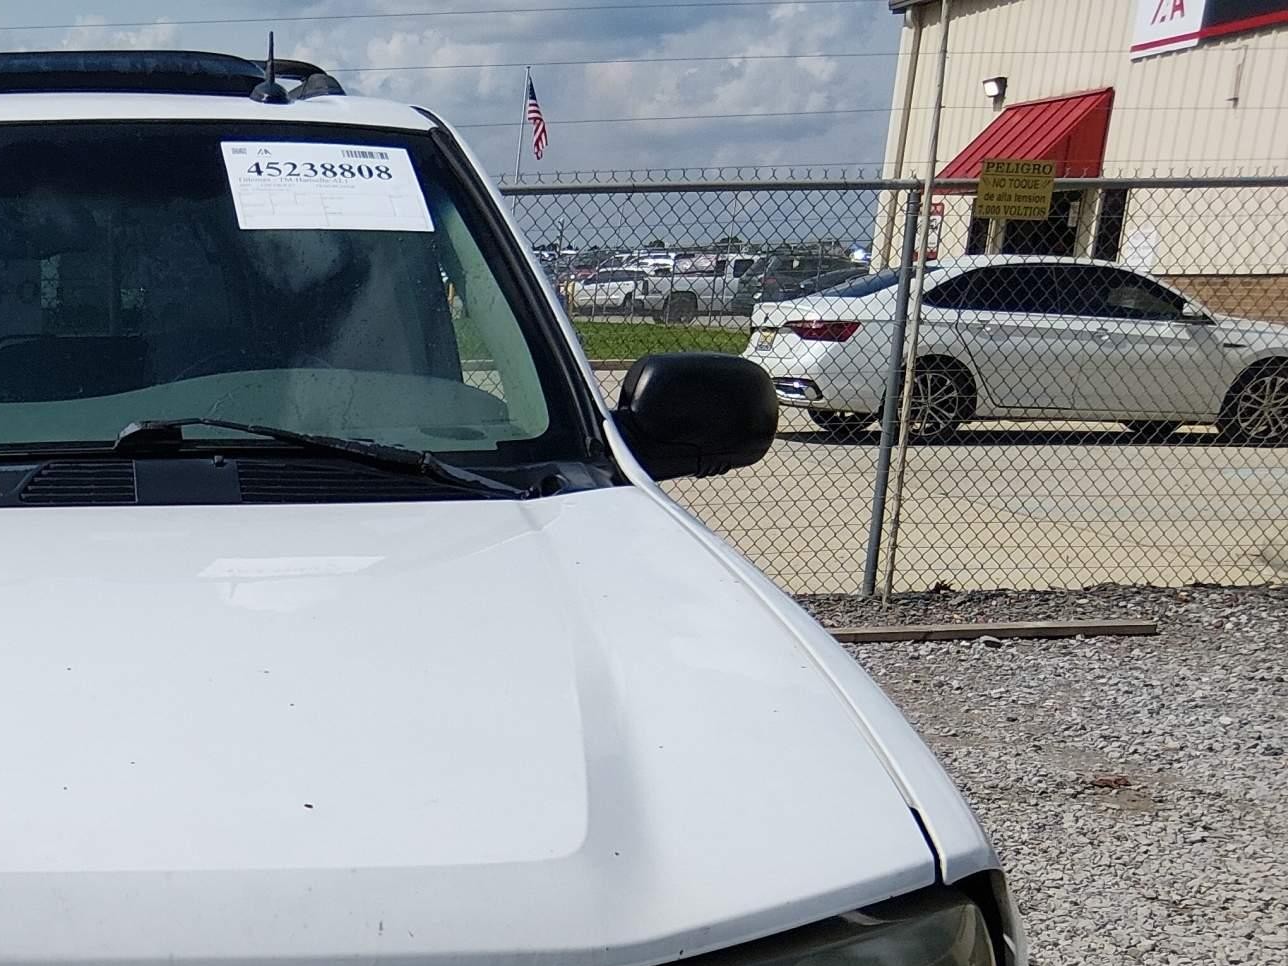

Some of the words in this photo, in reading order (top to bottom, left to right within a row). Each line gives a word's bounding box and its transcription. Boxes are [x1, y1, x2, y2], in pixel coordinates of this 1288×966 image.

[247, 161, 393, 181] 45238808
[985, 161, 1053, 175] PELIGRO
[992, 178, 1006, 189] NO
[1009, 178, 1041, 190] TOQUE
[996, 191, 1012, 202] alta
[1003, 205, 1047, 217] VOLTIOS
